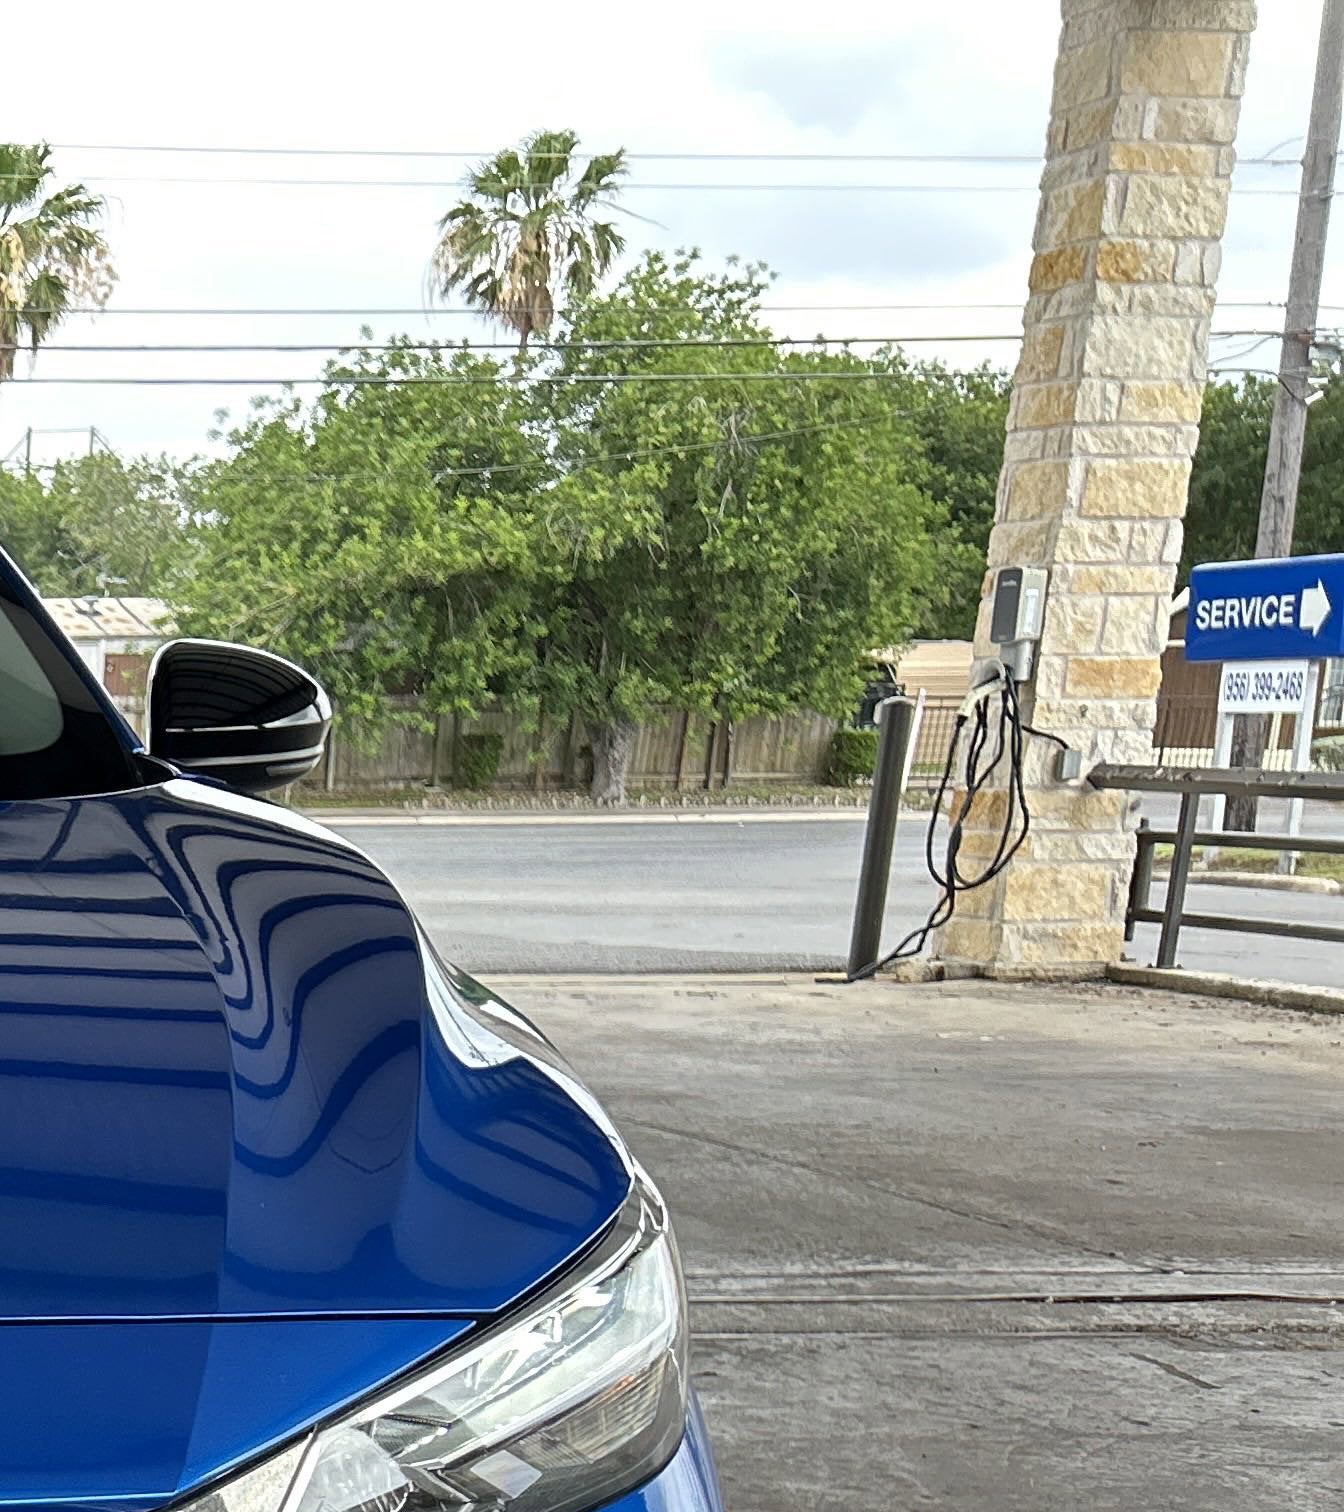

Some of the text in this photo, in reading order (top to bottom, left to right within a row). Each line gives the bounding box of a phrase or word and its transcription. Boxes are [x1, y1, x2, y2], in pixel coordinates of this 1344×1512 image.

[1196, 595, 1296, 630] SERVICE
[1223, 671, 1304, 702] (956) 399-2468
